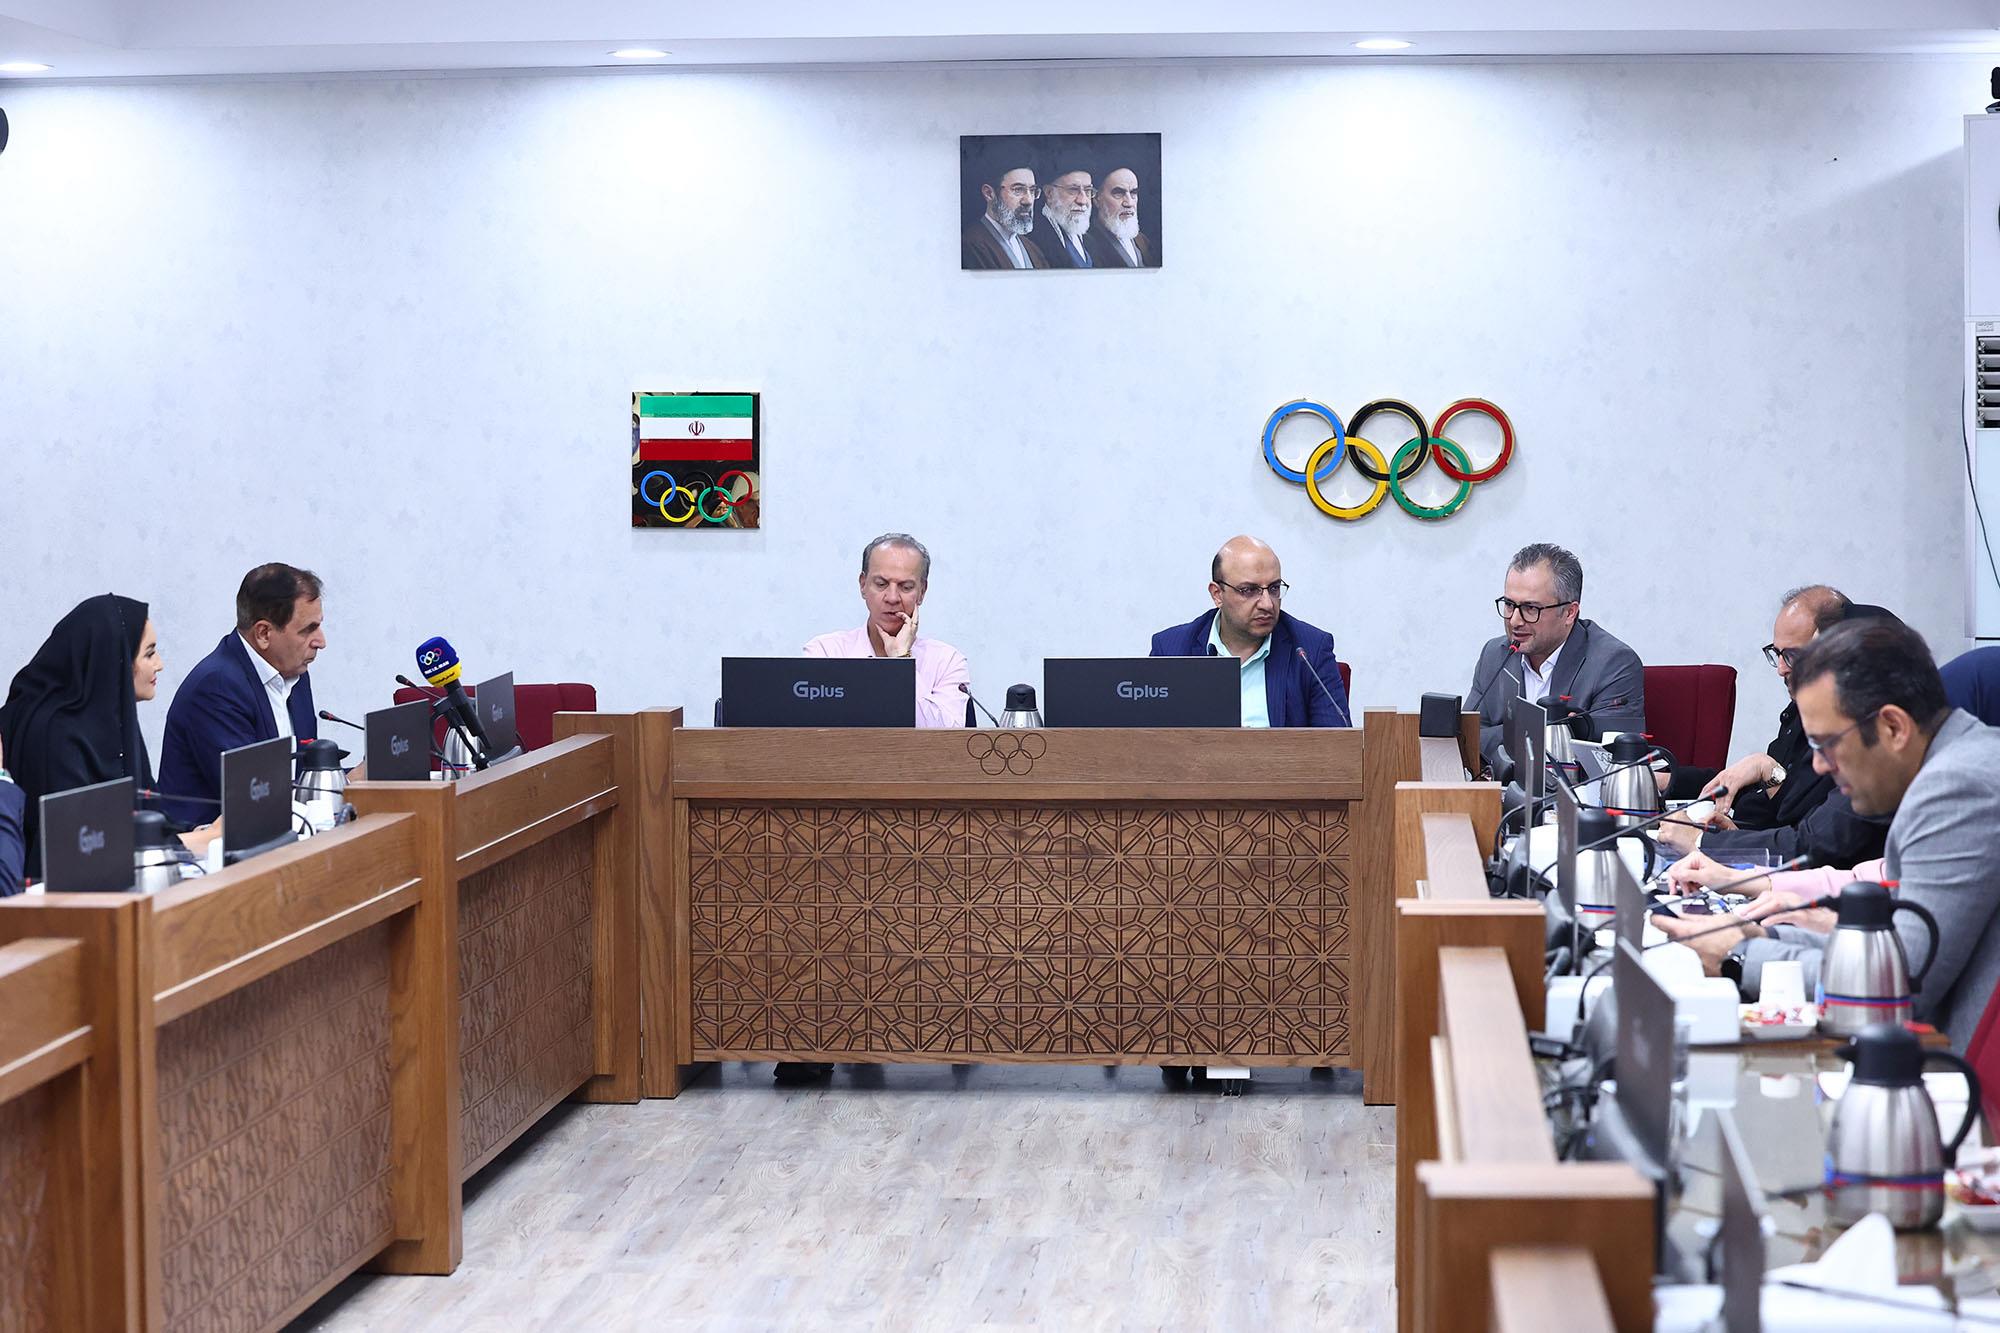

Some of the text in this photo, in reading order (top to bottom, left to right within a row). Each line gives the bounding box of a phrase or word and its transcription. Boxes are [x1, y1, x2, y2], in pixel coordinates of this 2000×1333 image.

[792, 680, 845, 700] Gplus
[1116, 680, 1169, 701] Gplus
[390, 735, 409, 757] Gplus
[249, 776, 270, 803] Gplus
